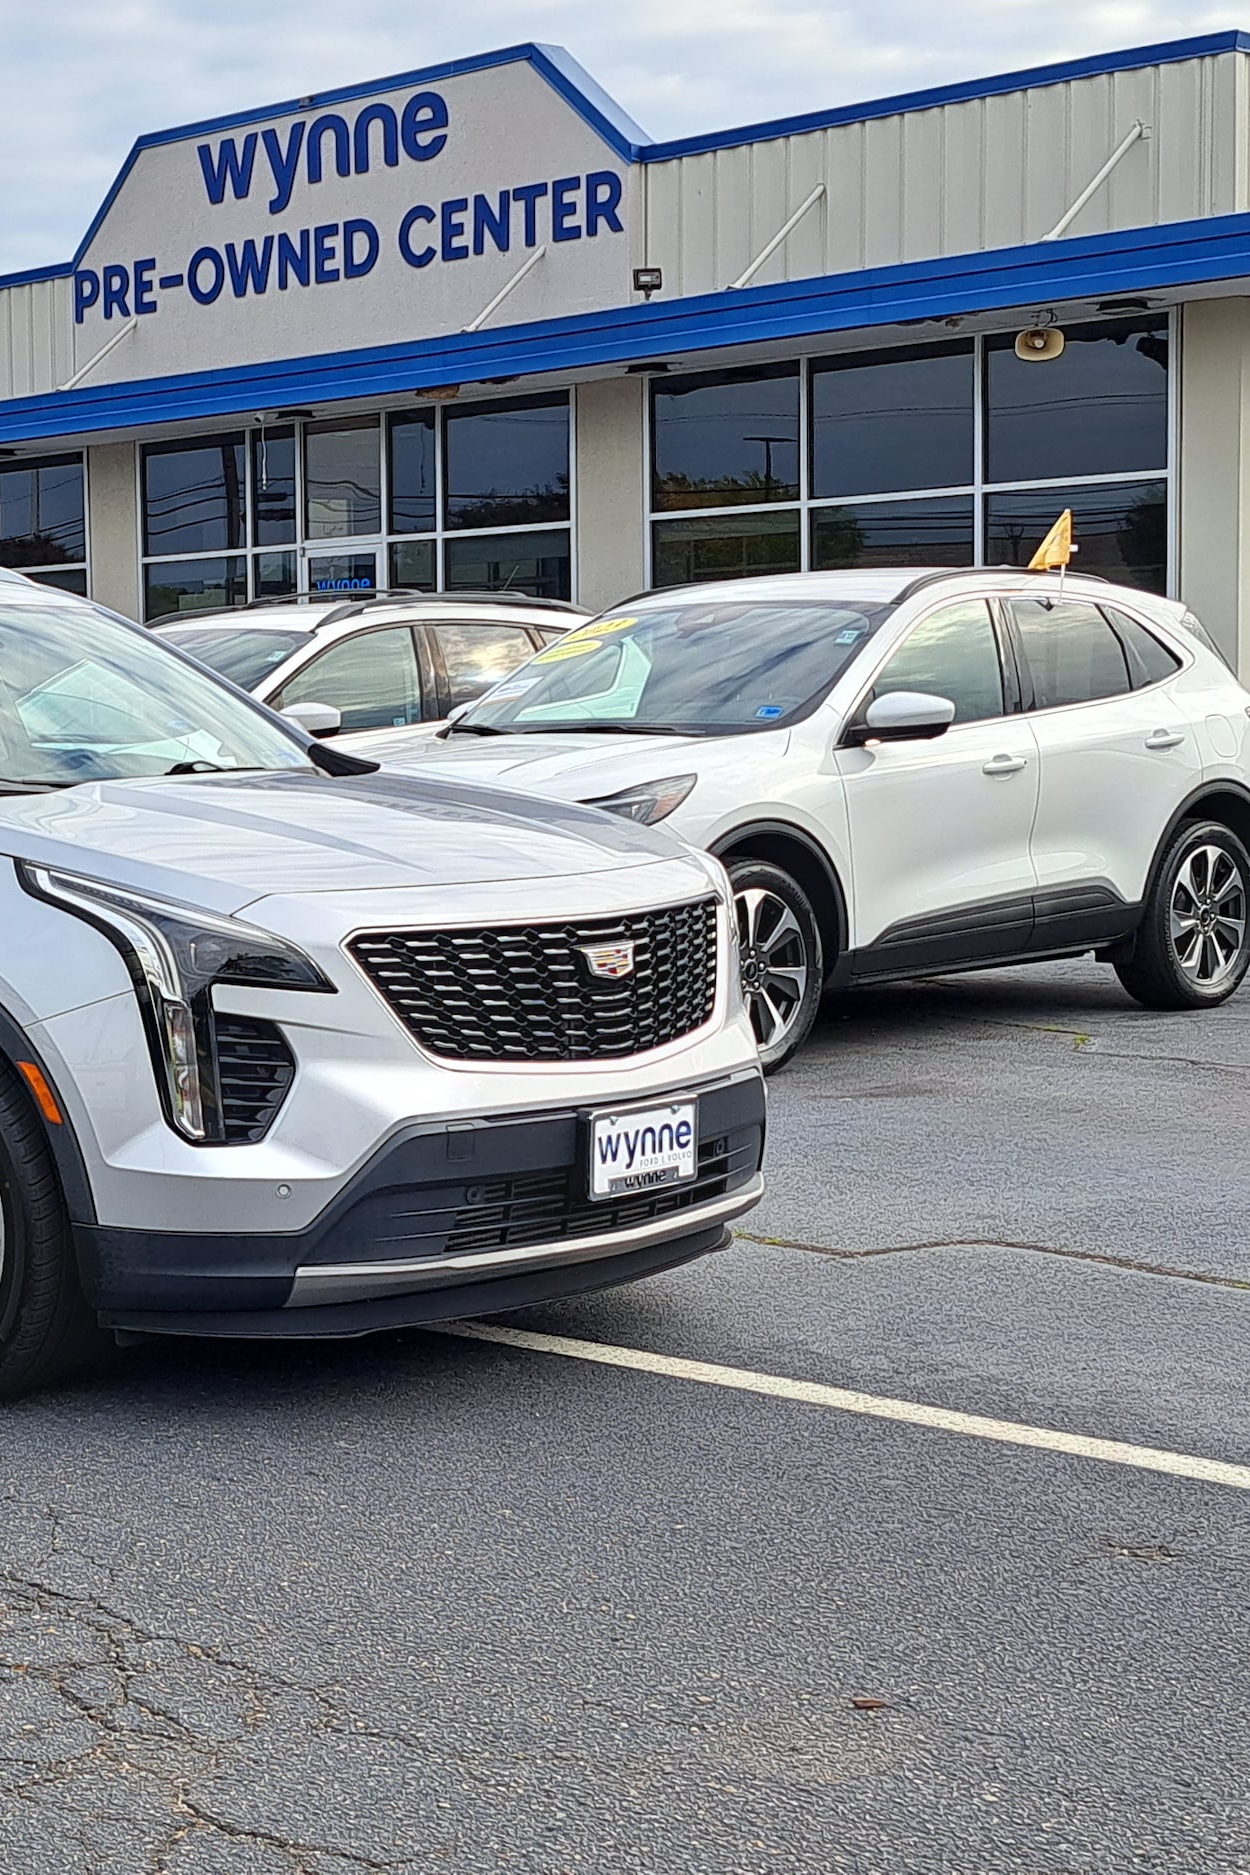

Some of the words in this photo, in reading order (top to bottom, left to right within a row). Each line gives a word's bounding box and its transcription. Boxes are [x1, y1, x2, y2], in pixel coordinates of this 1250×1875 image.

[196, 91, 448, 214] wynne
[74, 218, 379, 324] PRE-OWNED
[398, 170, 624, 268] CENTER
[598, 1120, 692, 1170] wynne
[667, 1150, 692, 1162] VOLVO
[624, 1170, 666, 1188] wynne
